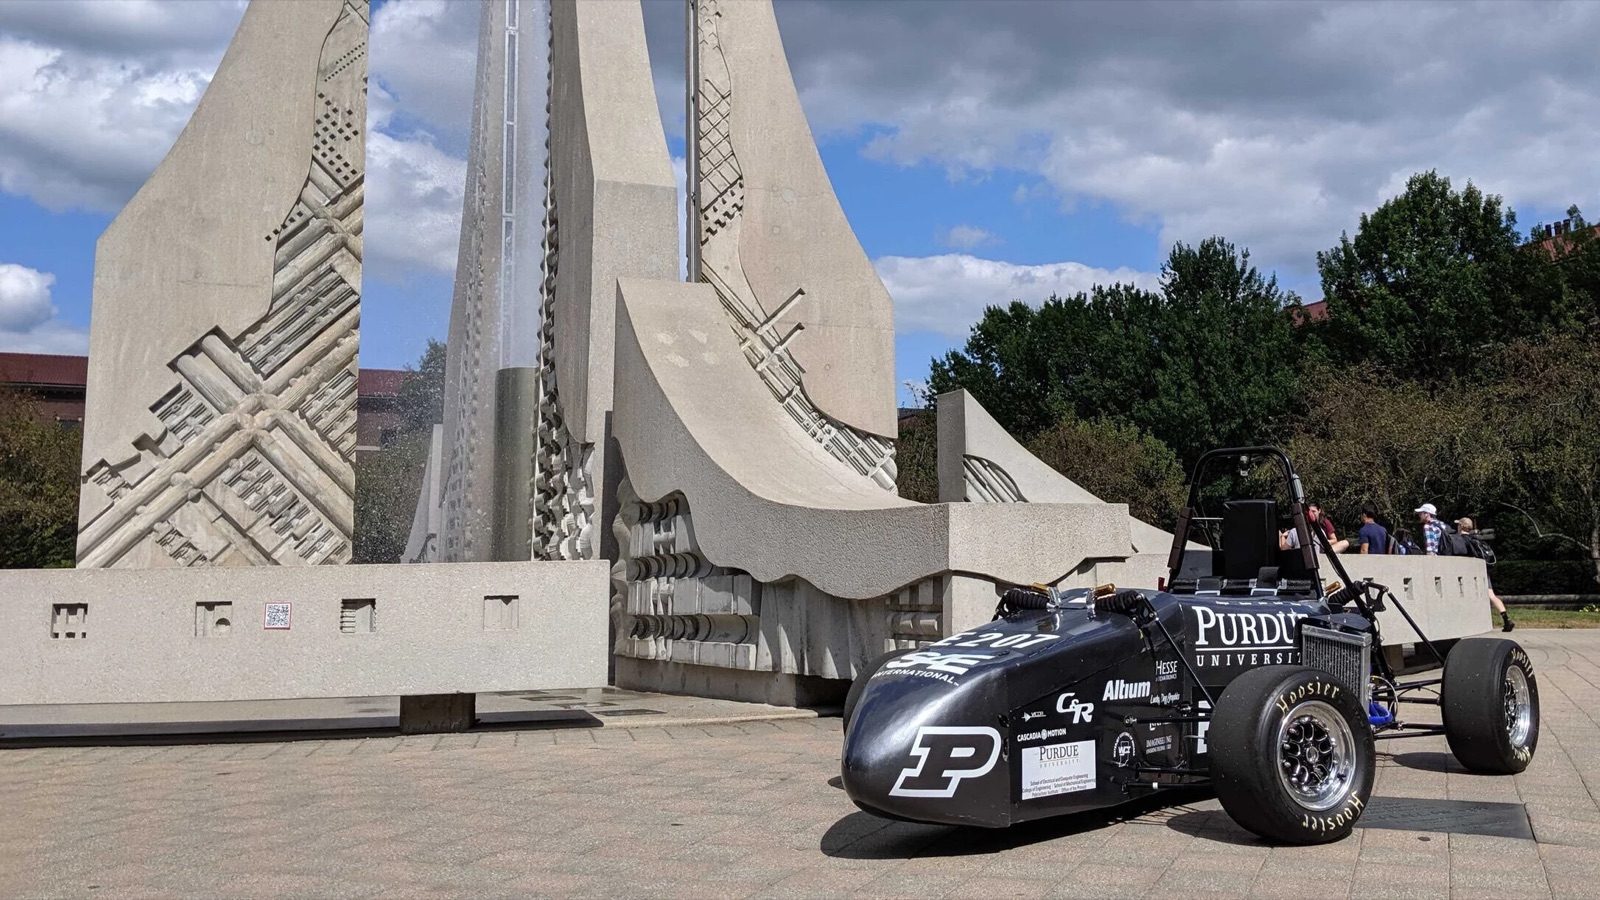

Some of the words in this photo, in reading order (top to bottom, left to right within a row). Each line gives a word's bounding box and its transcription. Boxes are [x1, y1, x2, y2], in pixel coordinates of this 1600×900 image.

[1191, 605, 1309, 646] PURDU
[886, 651, 996, 675] SAE
[1155, 660, 1178, 675] HESSE
[1197, 652, 1302, 667] UNIVERSIT
[1102, 679, 1151, 702] Altium
[1276, 676, 1341, 716] Hoosier
[1056, 692, 1094, 724] C&R
[1017, 731, 1042, 742] CASCADIA
[1047, 728, 1067, 738] MOTION
[888, 726, 1001, 798] P
[1040, 745, 1079, 761] PURDUE
[1302, 790, 1364, 837] Hoosier
